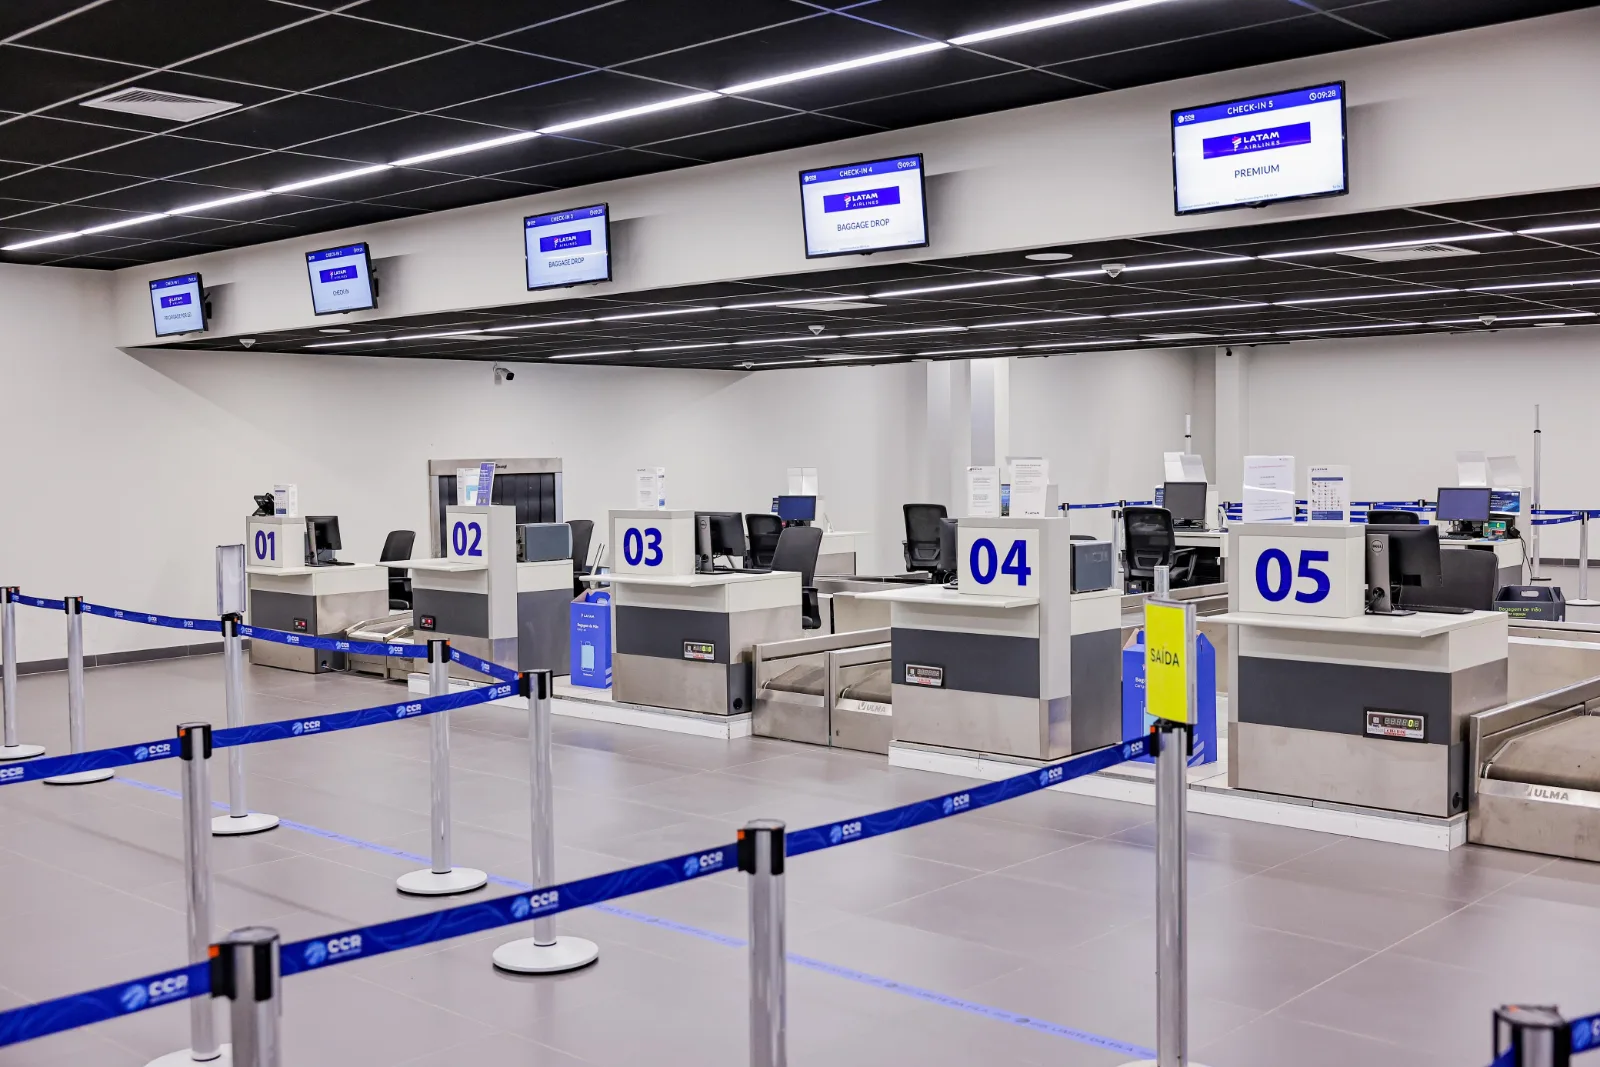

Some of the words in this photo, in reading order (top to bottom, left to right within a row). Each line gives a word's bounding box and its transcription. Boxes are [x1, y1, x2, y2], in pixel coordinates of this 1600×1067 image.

[1317, 90, 1336, 100] 09:28
[1227, 101, 1267, 115] CHECK-IN
[1268, 100, 1274, 108] 5
[1244, 132, 1280, 144] LATAM
[1244, 140, 1280, 150] AIRLINES
[840, 167, 868, 177] CHECK-IN
[1234, 164, 1280, 178] PREMIUM
[852, 192, 878, 202] LATAM
[837, 220, 870, 232] BAGGAGE
[870, 218, 890, 228] DROP
[548, 258, 570, 268] BAGGAGE
[255, 530, 276, 560] 01
[452, 521, 483, 557] 02
[623, 527, 664, 566] 03
[970, 537, 1032, 586] 04
[1255, 548, 1331, 604] 05
[1150, 646, 1180, 667] SAÍDA
[498, 685, 511, 694] CCR
[406, 704, 422, 712] CCR
[304, 720, 320, 729] CCR
[149, 744, 170, 754] CCR
[1131, 740, 1144, 752] CCR
[1048, 766, 1063, 779] CCR
[953, 794, 969, 807] CCR
[1534, 788, 1569, 800] ULMA
[842, 821, 861, 836] CCR
[700, 851, 723, 867] CCR
[530, 890, 559, 908] CCR
[328, 934, 362, 954] CCR
[149, 974, 188, 998] CCR
